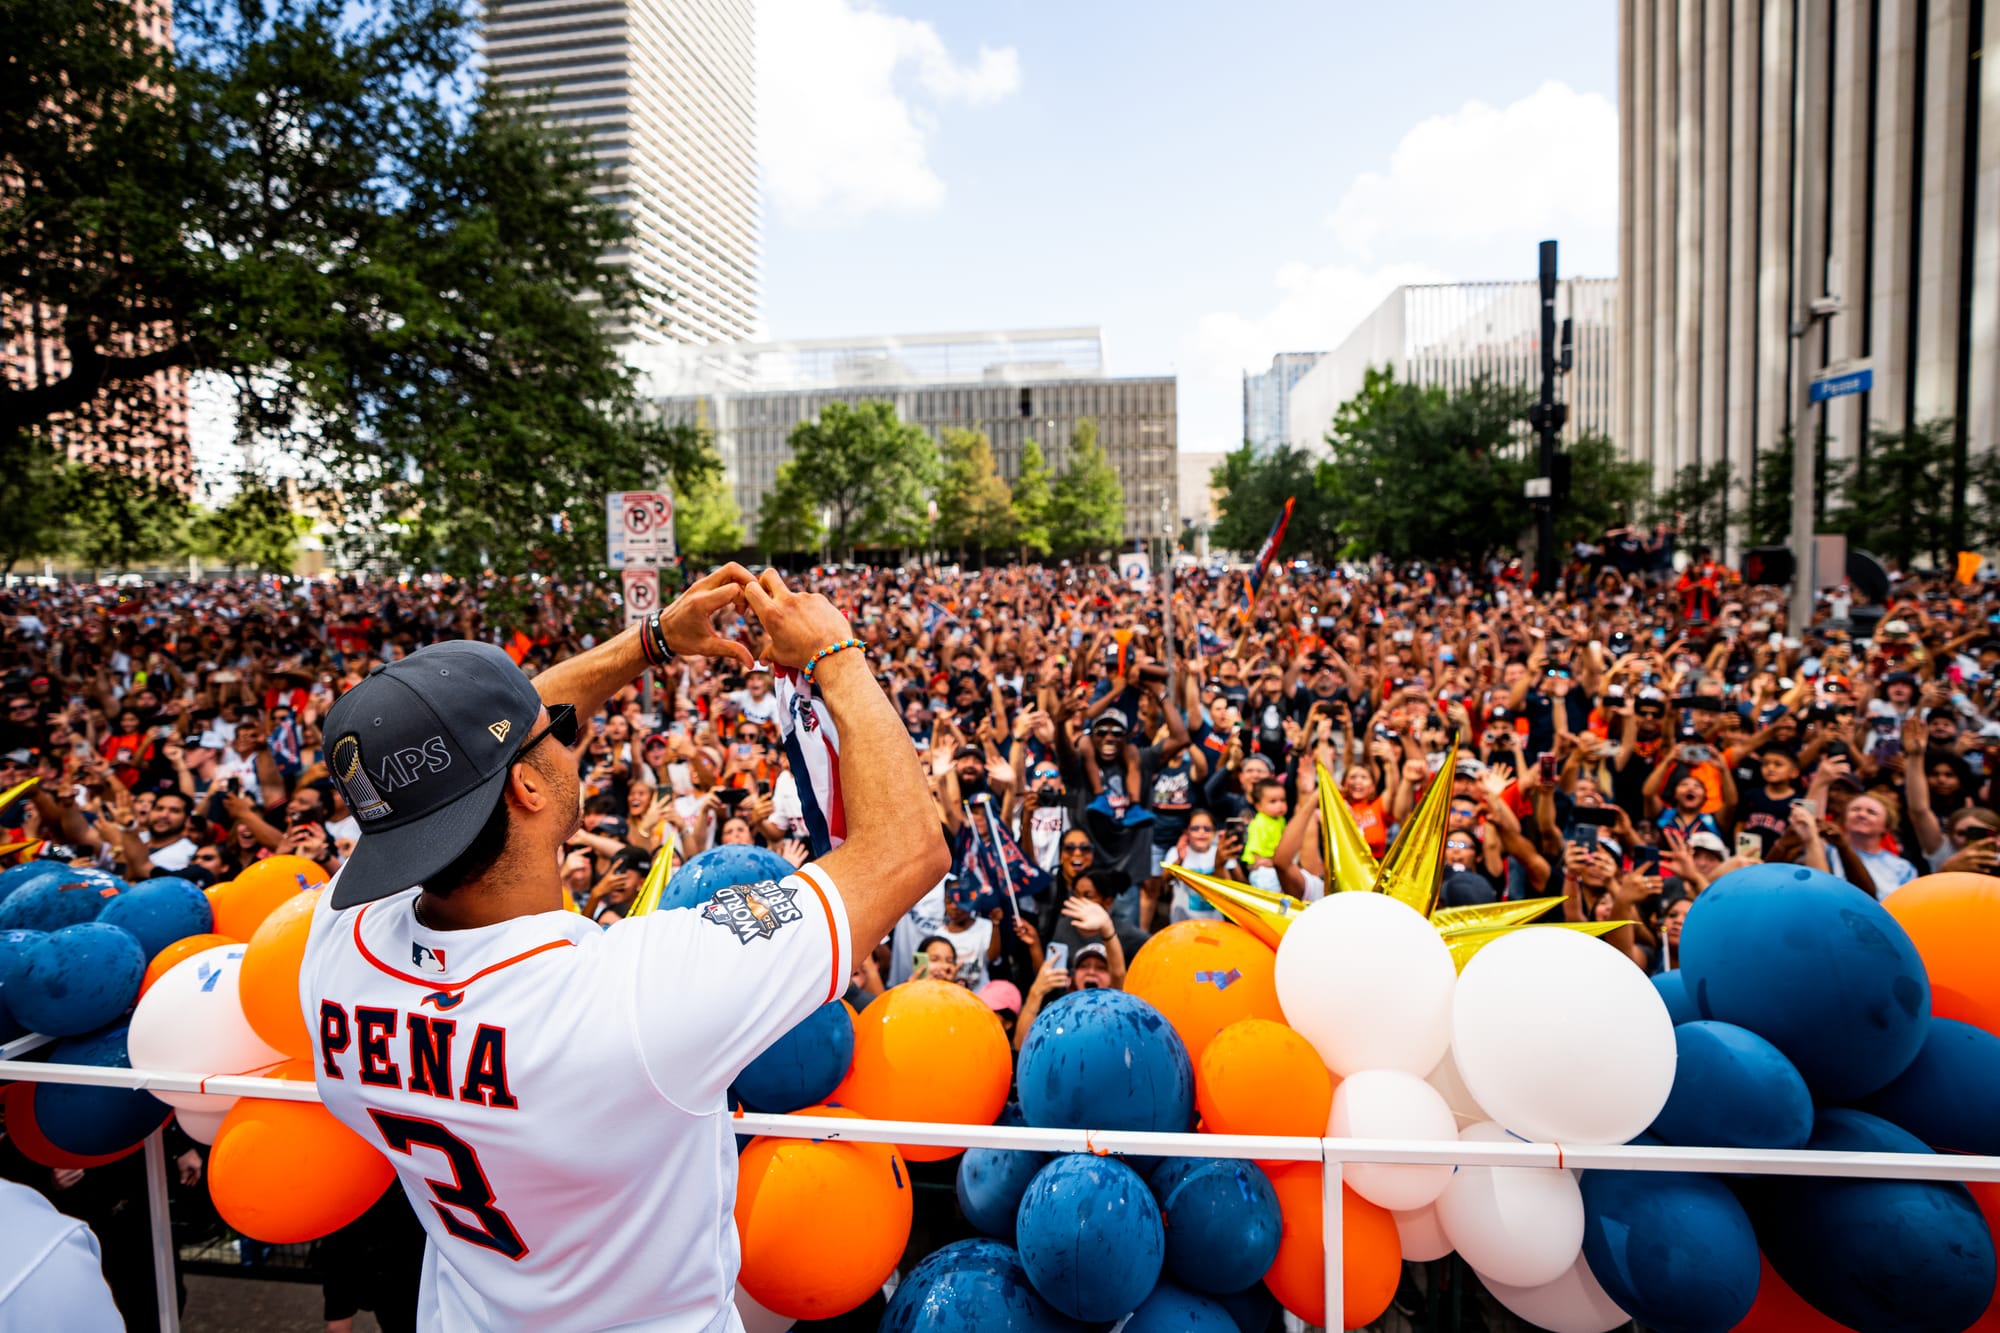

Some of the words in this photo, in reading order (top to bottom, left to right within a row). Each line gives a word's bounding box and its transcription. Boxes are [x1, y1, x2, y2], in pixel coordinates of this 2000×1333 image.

[715, 888, 761, 941] WORLD
[754, 879, 800, 923] SERIES
[366, 1107, 530, 1262] 3
